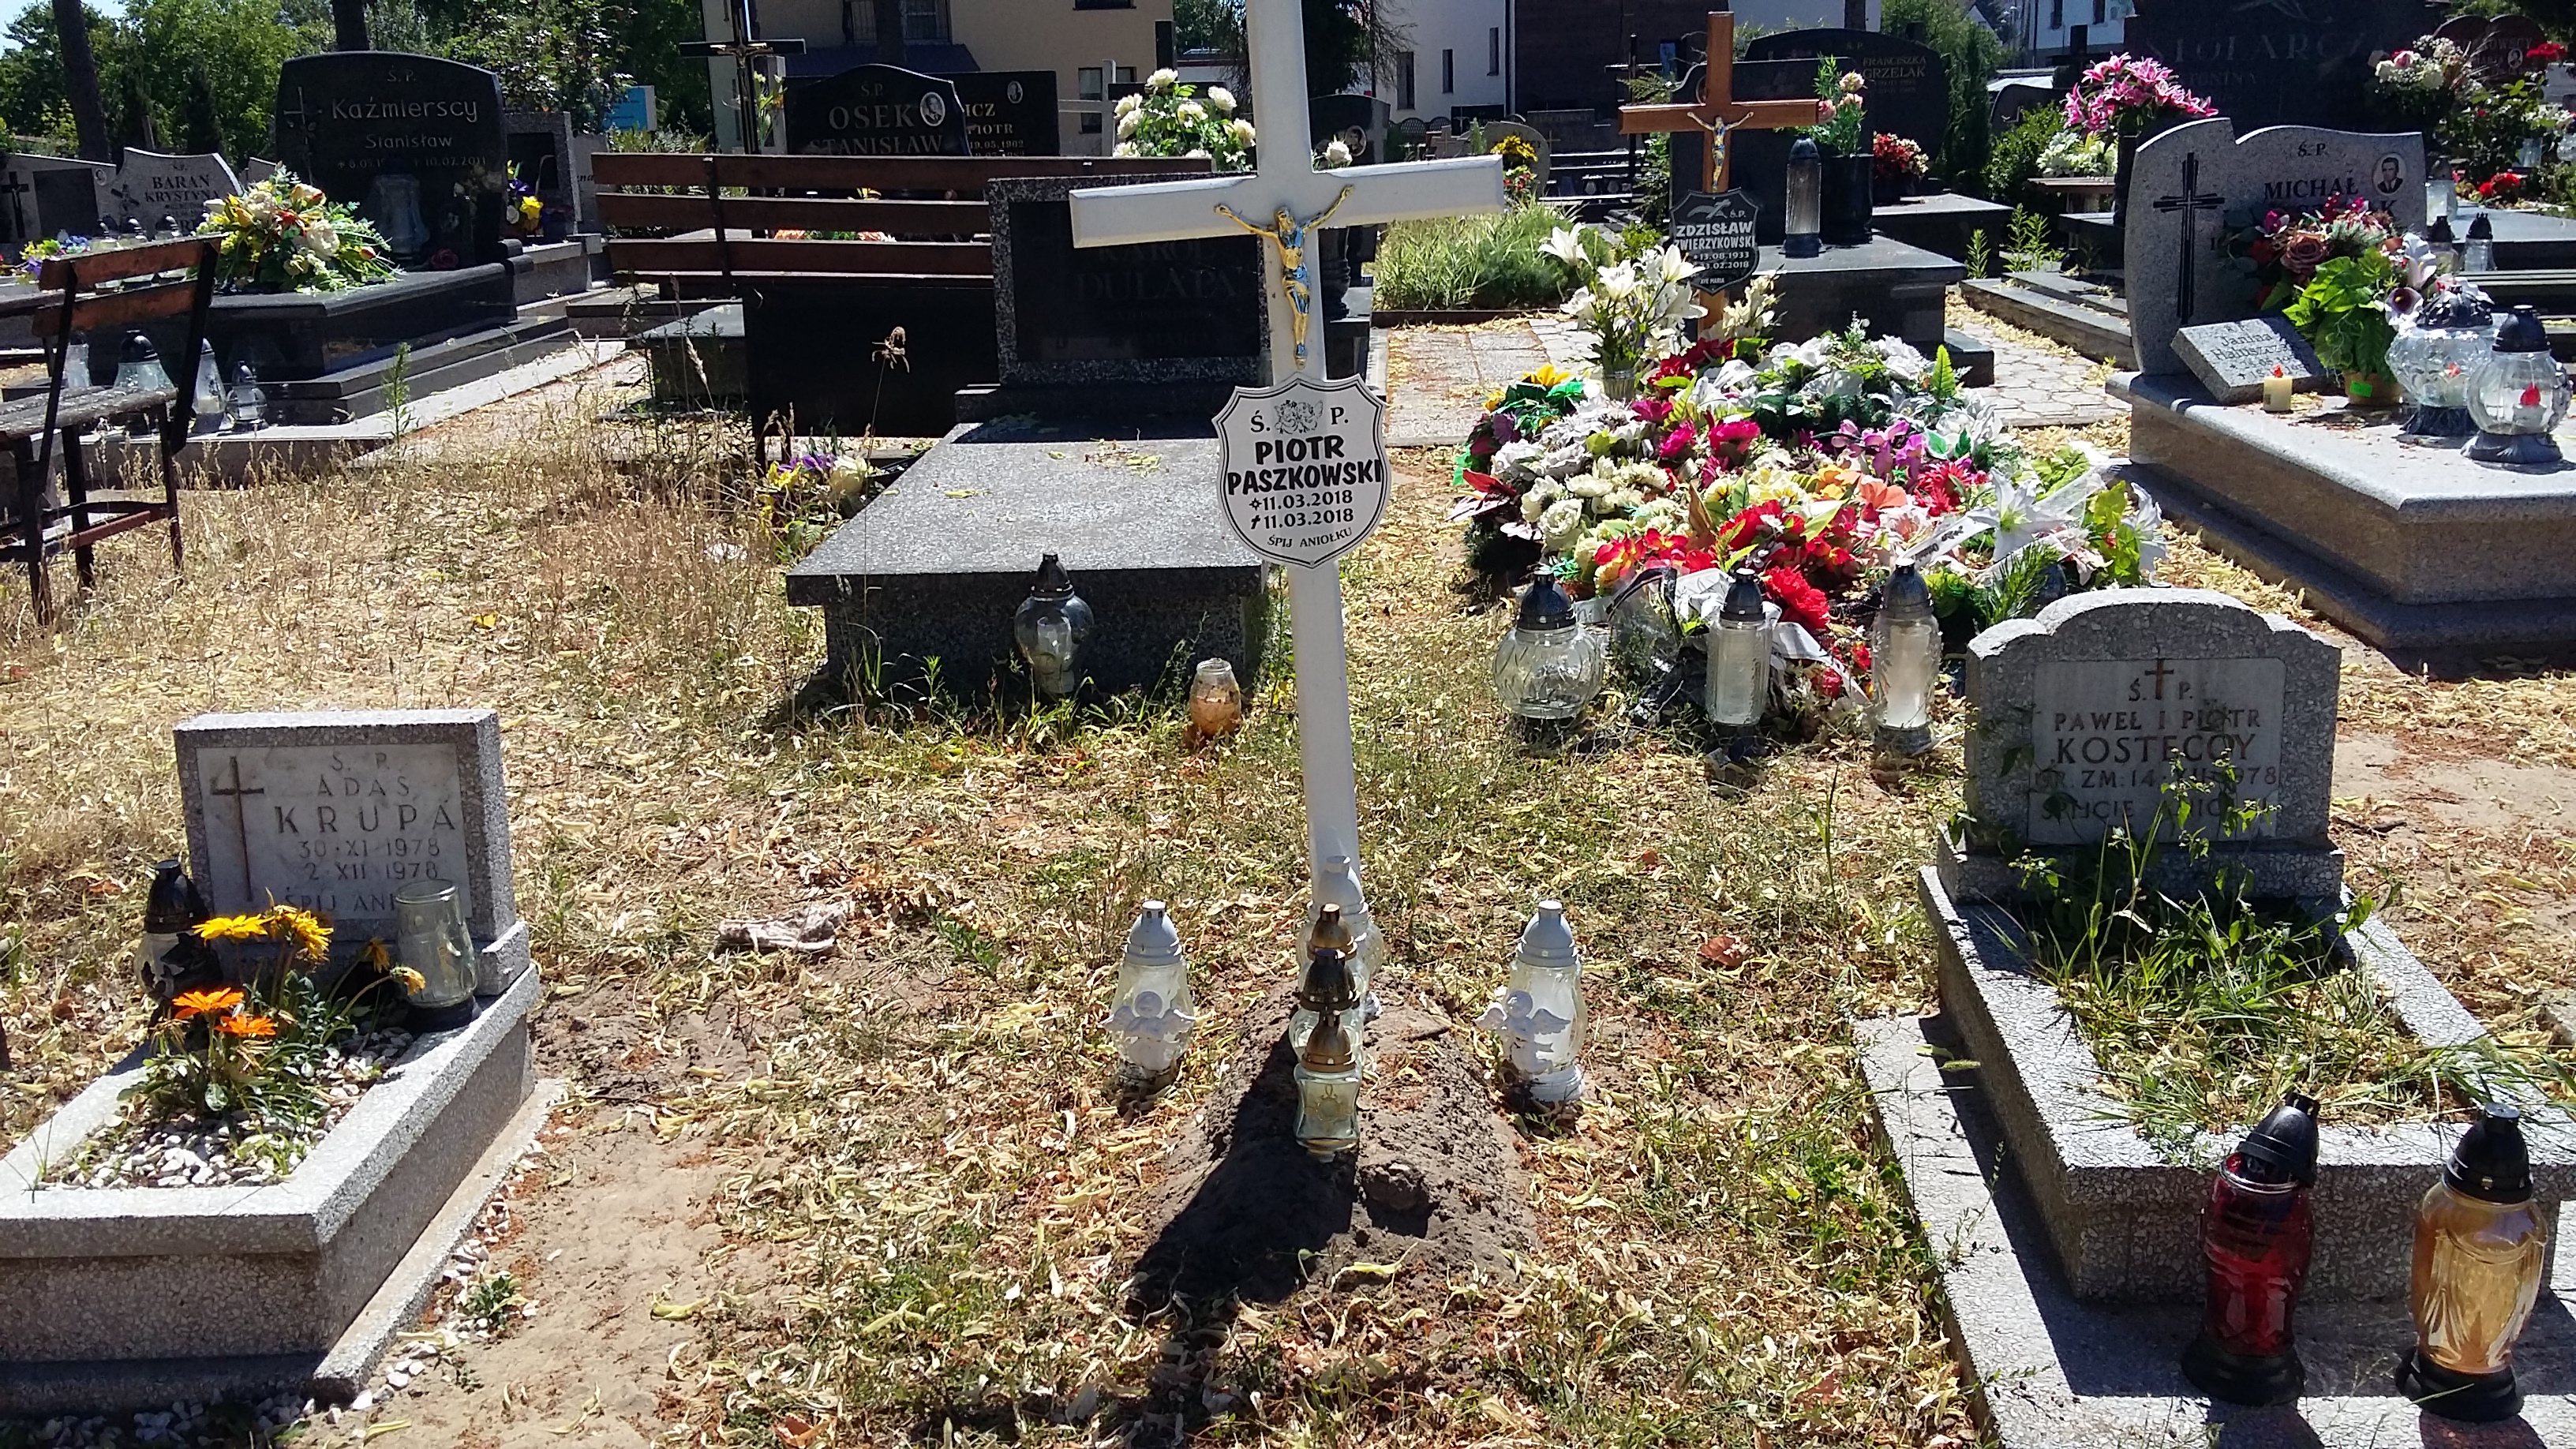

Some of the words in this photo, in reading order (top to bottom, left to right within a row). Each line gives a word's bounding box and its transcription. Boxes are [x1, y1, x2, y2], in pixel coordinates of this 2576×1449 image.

[1863, 56, 1926, 66] FRANCISZKA
[1863, 66, 1926, 79] GRZELAK
[331, 96, 478, 124] Kaźmierscy
[829, 104, 915, 129] OSEK
[366, 134, 452, 148] Stanisław
[810, 135, 943, 155] STANISŁAW
[152, 174, 210, 189] BARAN
[2264, 178, 2359, 198] MICHAŁ
[145, 189, 221, 203] KRYSTYNA
[1676, 221, 1753, 238] ZDZISŁAW
[1674, 235, 1755, 251] ZWIERZYKOWSKI
[2222, 332, 2273, 346] Janina
[1251, 410, 1271, 432] Ś.
[1331, 406, 1349, 425] P.
[1255, 435, 1345, 465] PIOTR
[1227, 459, 1382, 496] PASZKOWSKI
[1263, 489, 1354, 511] 11.03.2018
[1264, 507, 1354, 530] 11.03.2018
[1267, 534, 1293, 548] ŚPIJ
[1299, 526, 1353, 548] ANIOŁKU
[2178, 681, 2194, 700] P.
[2054, 710, 2143, 732] PAWEŁ
[2158, 710, 2166, 730] I
[375, 752, 390, 770] P.
[317, 775, 410, 797] ADAS
[274, 803, 456, 834] KRUPA
